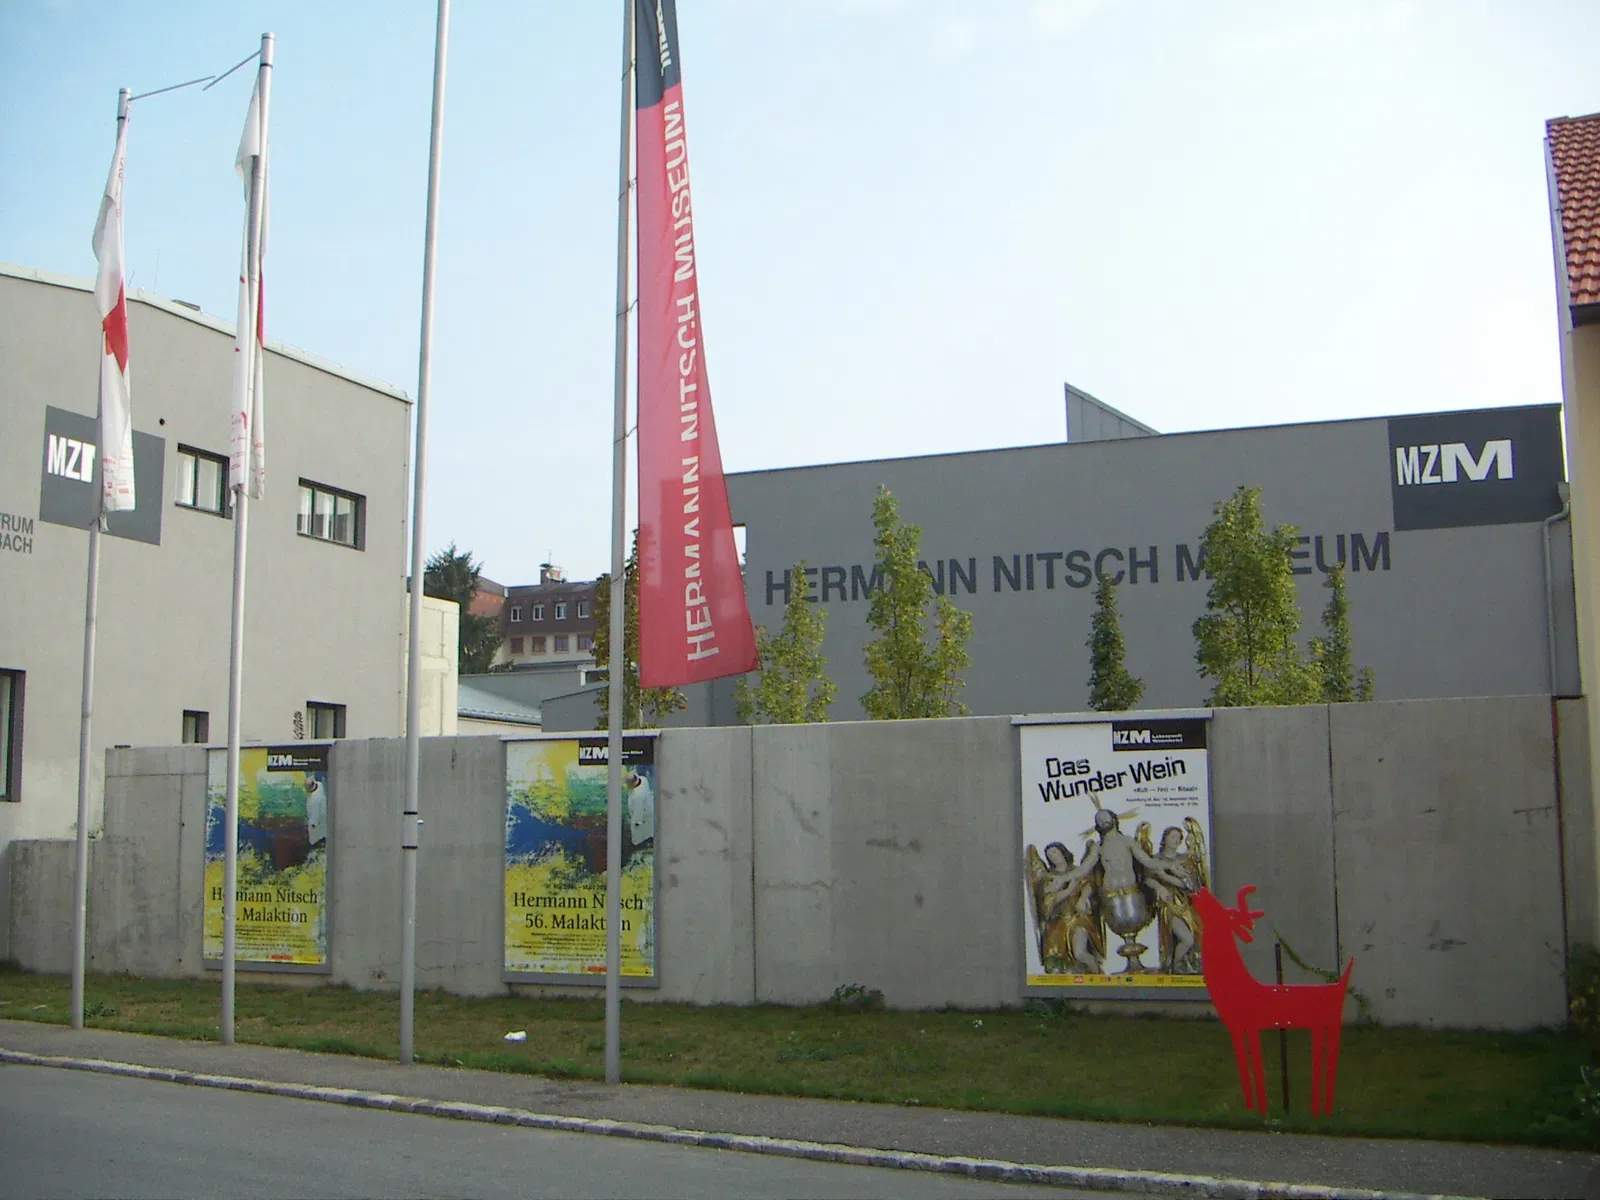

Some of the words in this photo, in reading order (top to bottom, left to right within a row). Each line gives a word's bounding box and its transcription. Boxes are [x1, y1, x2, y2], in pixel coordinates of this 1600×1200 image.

[1396, 439, 1514, 486] MZM
[765, 558, 978, 605] HERMNN
[993, 547, 1159, 592] NITSCH
[1175, 531, 1391, 582] MEUM
[1045, 757, 1091, 779] Das
[1037, 770, 1128, 803] Wunder
[1128, 756, 1187, 785] Wein
[212, 886, 272, 903] Hmann
[276, 888, 318, 904] Nitsch
[513, 892, 588, 909] Hermann
[592, 893, 643, 911] Nsch
[242, 906, 308, 923] Malaktion
[525, 913, 548, 929] 56.
[551, 913, 632, 931] Malaktn
